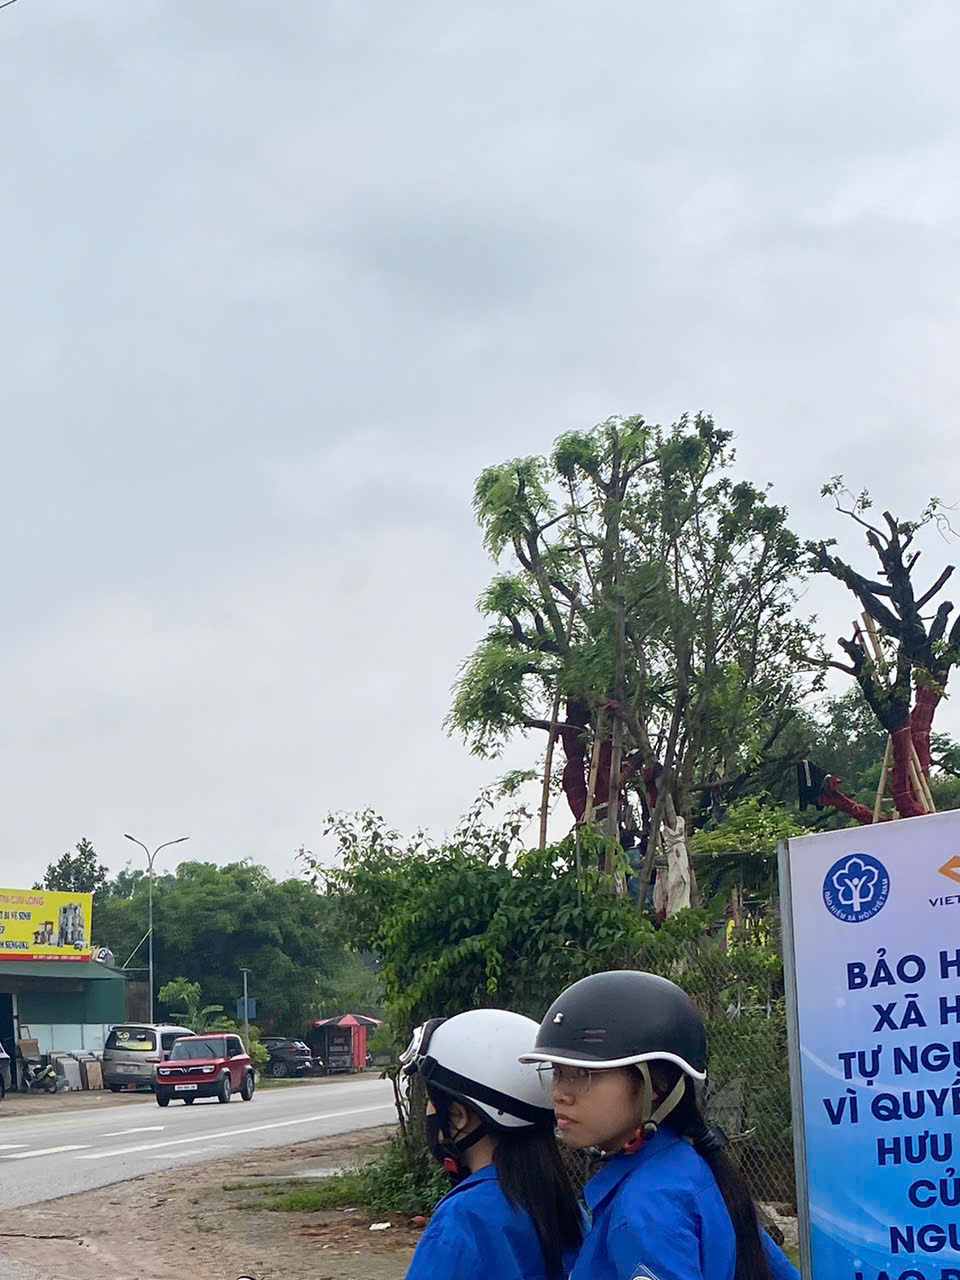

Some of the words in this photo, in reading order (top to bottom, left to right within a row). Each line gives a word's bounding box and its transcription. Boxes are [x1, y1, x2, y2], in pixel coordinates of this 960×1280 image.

[847, 947, 927, 991] BẢO
[872, 993, 928, 1033] XÃ
[838, 1044, 883, 1086] TỰ
[823, 1087, 859, 1125] VÌ
[876, 1130, 953, 1166] HƯU
